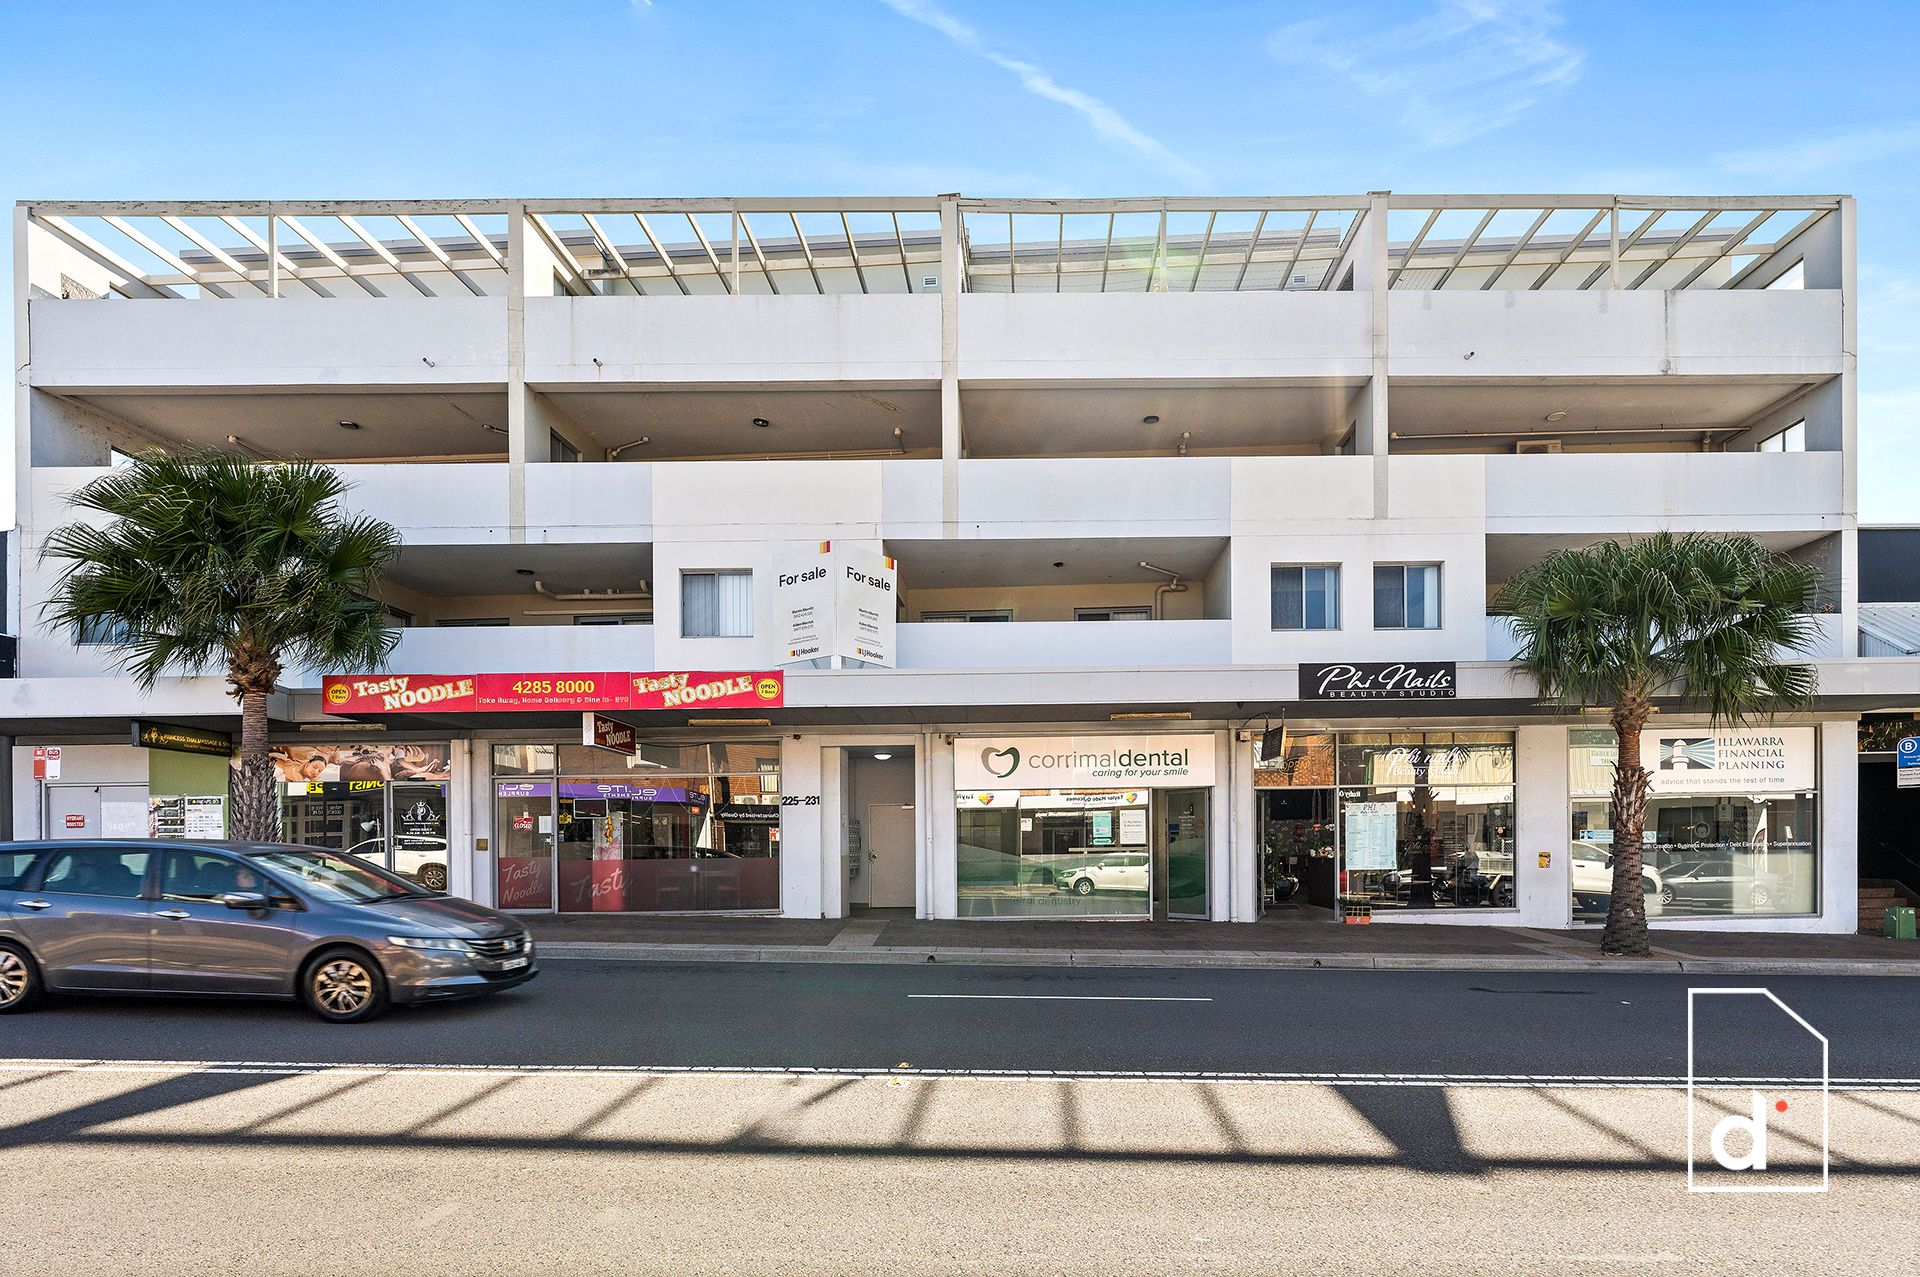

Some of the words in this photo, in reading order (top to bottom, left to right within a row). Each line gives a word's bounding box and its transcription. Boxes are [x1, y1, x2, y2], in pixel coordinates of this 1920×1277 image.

[779, 574, 799, 587] For
[801, 567, 827, 582] sale
[846, 566, 867, 583] For
[868, 577, 891, 591] sale
[796, 649, 801, 657] LJ
[801, 646, 820, 655] Hooker
[862, 649, 867, 657] LJ
[867, 650, 884, 660] Hooker
[352, 676, 409, 697] Tasty
[633, 673, 689, 695] Tasty
[1317, 664, 1375, 695] Phi
[1378, 664, 1451, 690] Nails
[512, 680, 552, 694] 4285
[556, 680, 595, 694] 8000
[661, 675, 754, 708] NOODLE
[1329, 690, 1387, 698] BEAUTY
[1399, 689, 1455, 697] STUDIO
[381, 678, 475, 711] NOODLE
[544, 697, 575, 705] Delivery
[596, 720, 614, 734] Tasty
[605, 730, 632, 747] NOODLE
[1718, 736, 1784, 747] ILLAWARRA
[1718, 748, 1785, 758] FINANCIAL
[1904, 741, 1913, 751] B
[1028, 748, 1189, 769] corrimaldental
[1718, 760, 1785, 770] PLANNING
[1092, 768, 1121, 779] caring
[1124, 768, 1137, 777] for
[1140, 769, 1160, 779] your
[1163, 767, 1189, 777] smile
[1660, 777, 1684, 785] advice
[1686, 777, 1700, 785] that
[1702, 777, 1727, 785] stands
[1759, 776, 1767, 784] of
[1769, 776, 1785, 784] time
[1677, 842, 1700, 850] Business
[1772, 840, 1812, 848] Superannuation
[502, 860, 543, 883] Tasty
[502, 880, 544, 905] Noodle
